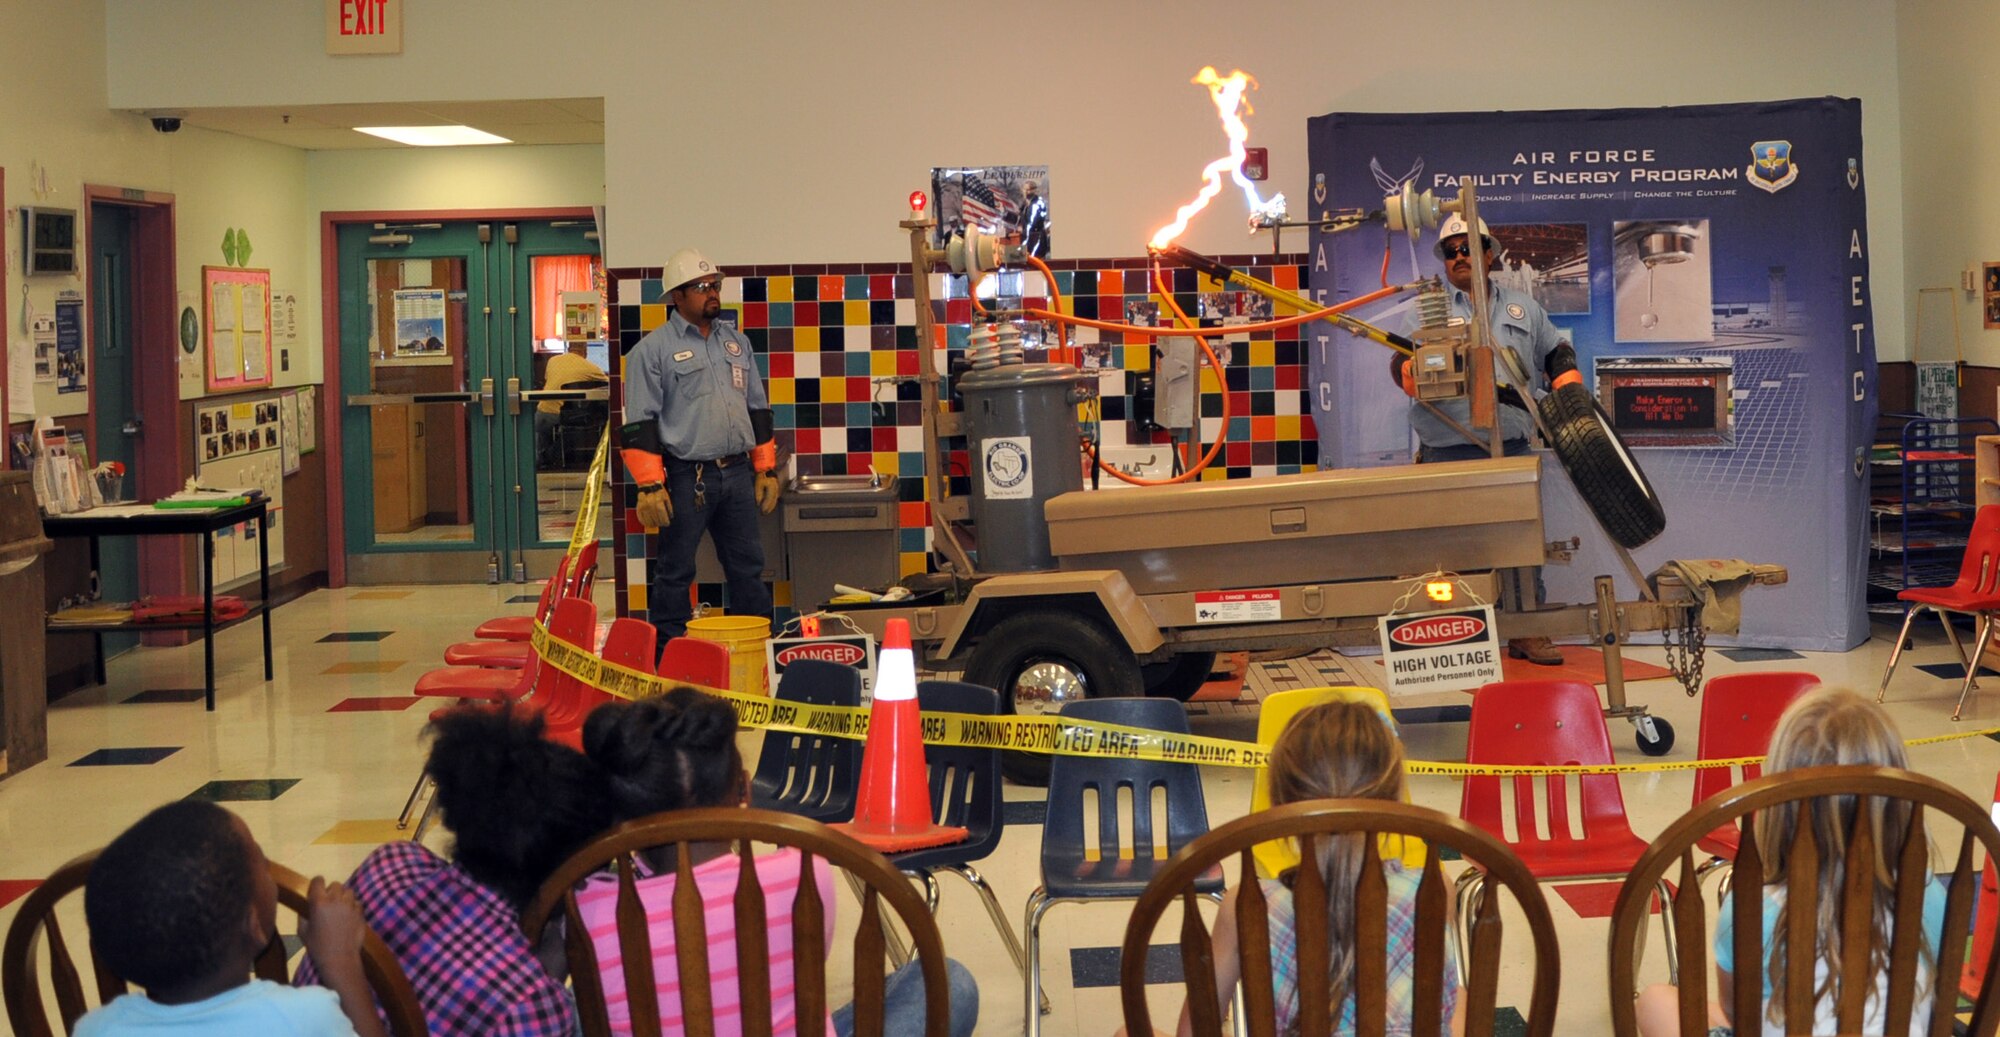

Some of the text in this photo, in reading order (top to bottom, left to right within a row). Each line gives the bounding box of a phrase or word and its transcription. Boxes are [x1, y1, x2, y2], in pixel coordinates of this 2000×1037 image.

[340, 0, 388, 35] EXIT
[1512, 149, 1656, 165] AIR FORCE
[983, 170, 1045, 180] LEADERSHIP
[1533, 170, 1620, 185] ENERGY
[1631, 167, 1738, 183] PROGRAM
[1531, 193, 1577, 201] INCREASE
[1580, 192, 1615, 200] SUPPLY
[1634, 190, 1672, 198] CHANGE
[1675, 190, 1693, 198] THE
[1696, 189, 1738, 197] CULTURE
[1401, 620, 1476, 642] DANGER
[786, 648, 856, 663] DANGER
[1393, 650, 1493, 673] HIGH VOLTAGE
[1394, 668, 1495, 686] Authorized Personnel Only
[805, 711, 851, 734] WARNING
[959, 720, 1139, 757] WARNING RESTRICTED AREA
